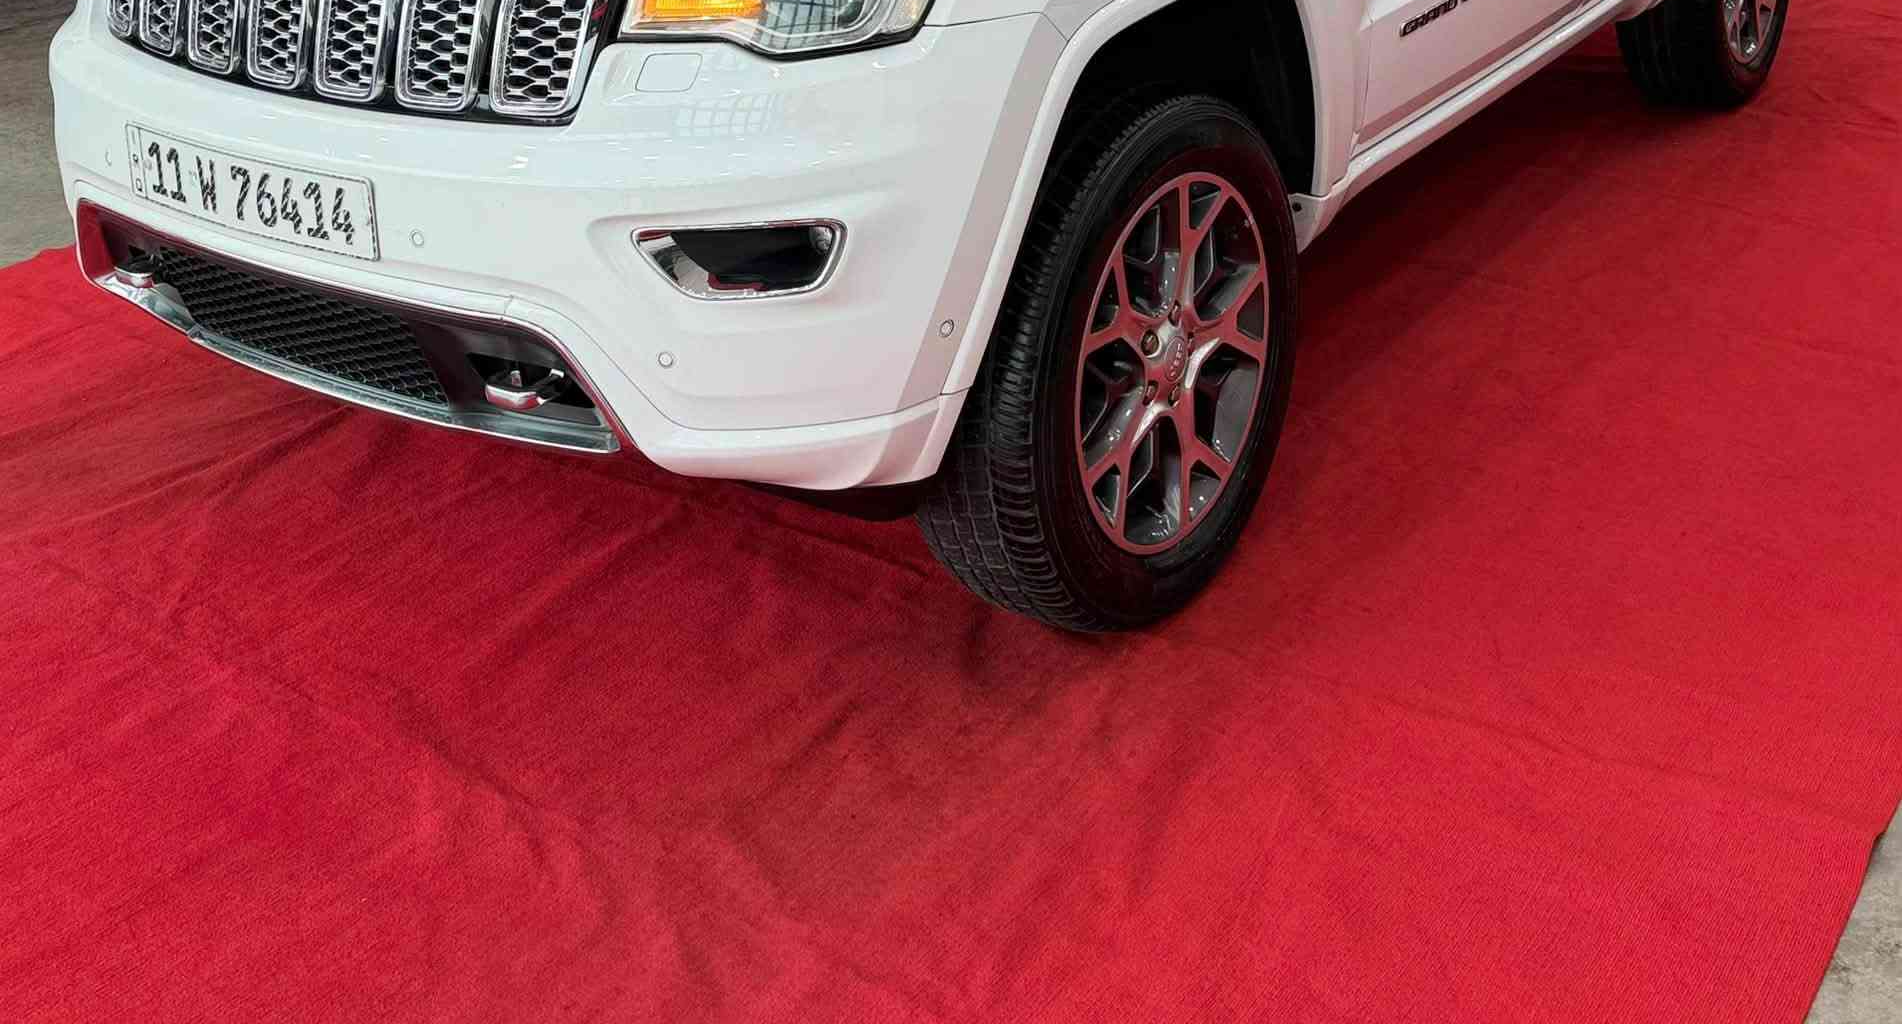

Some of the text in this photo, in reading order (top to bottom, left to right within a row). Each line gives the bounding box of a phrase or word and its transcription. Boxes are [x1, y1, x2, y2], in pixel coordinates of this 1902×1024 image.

[148, 141, 355, 246] 11 W 76414
